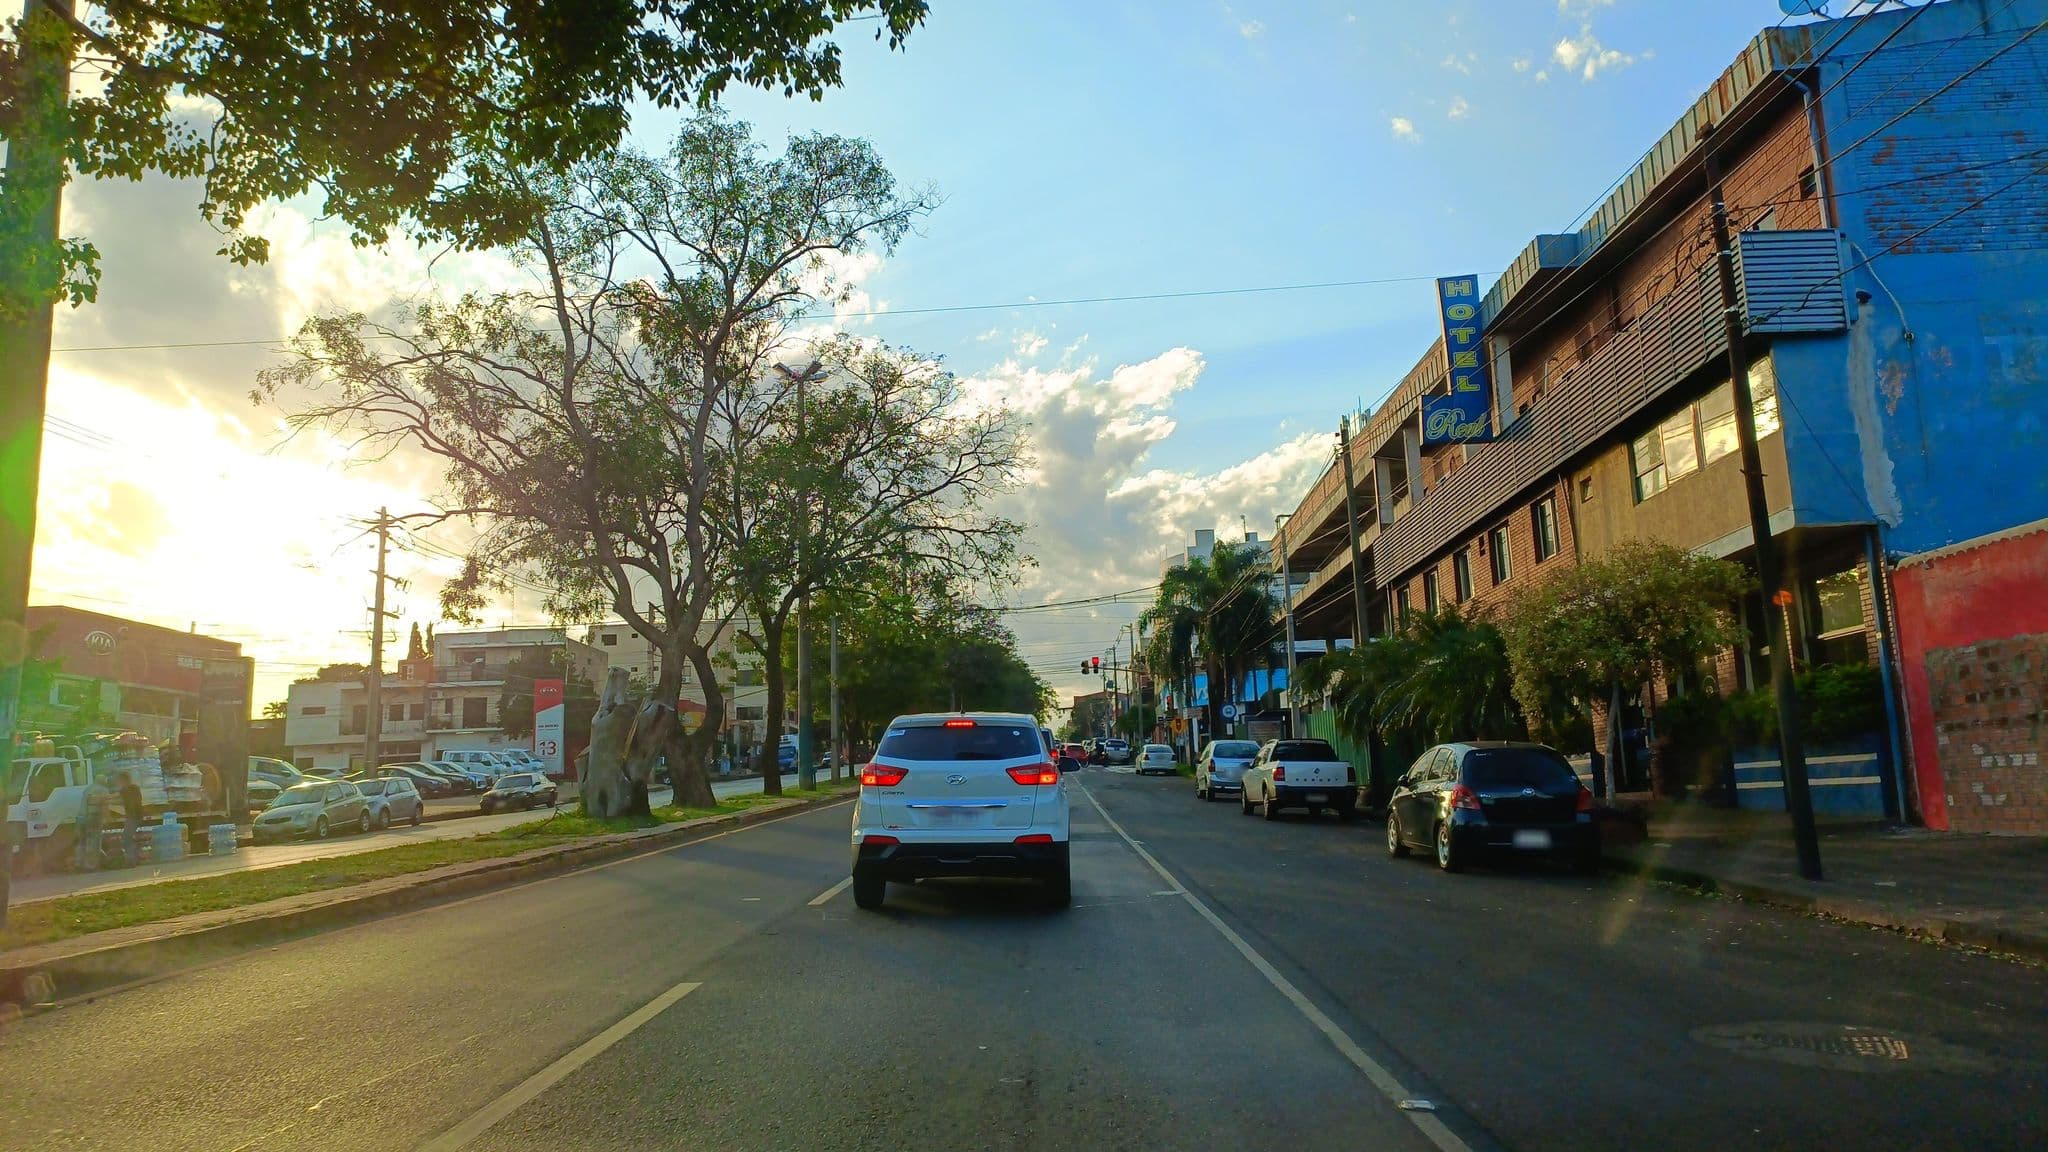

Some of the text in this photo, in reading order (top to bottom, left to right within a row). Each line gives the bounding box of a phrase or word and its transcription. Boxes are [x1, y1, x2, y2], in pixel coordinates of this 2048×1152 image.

[1445, 280, 1480, 392] HOTEL
[1425, 408, 1486, 440] Real
[91, 635, 111, 648] KIA
[539, 741, 557, 755] 13
